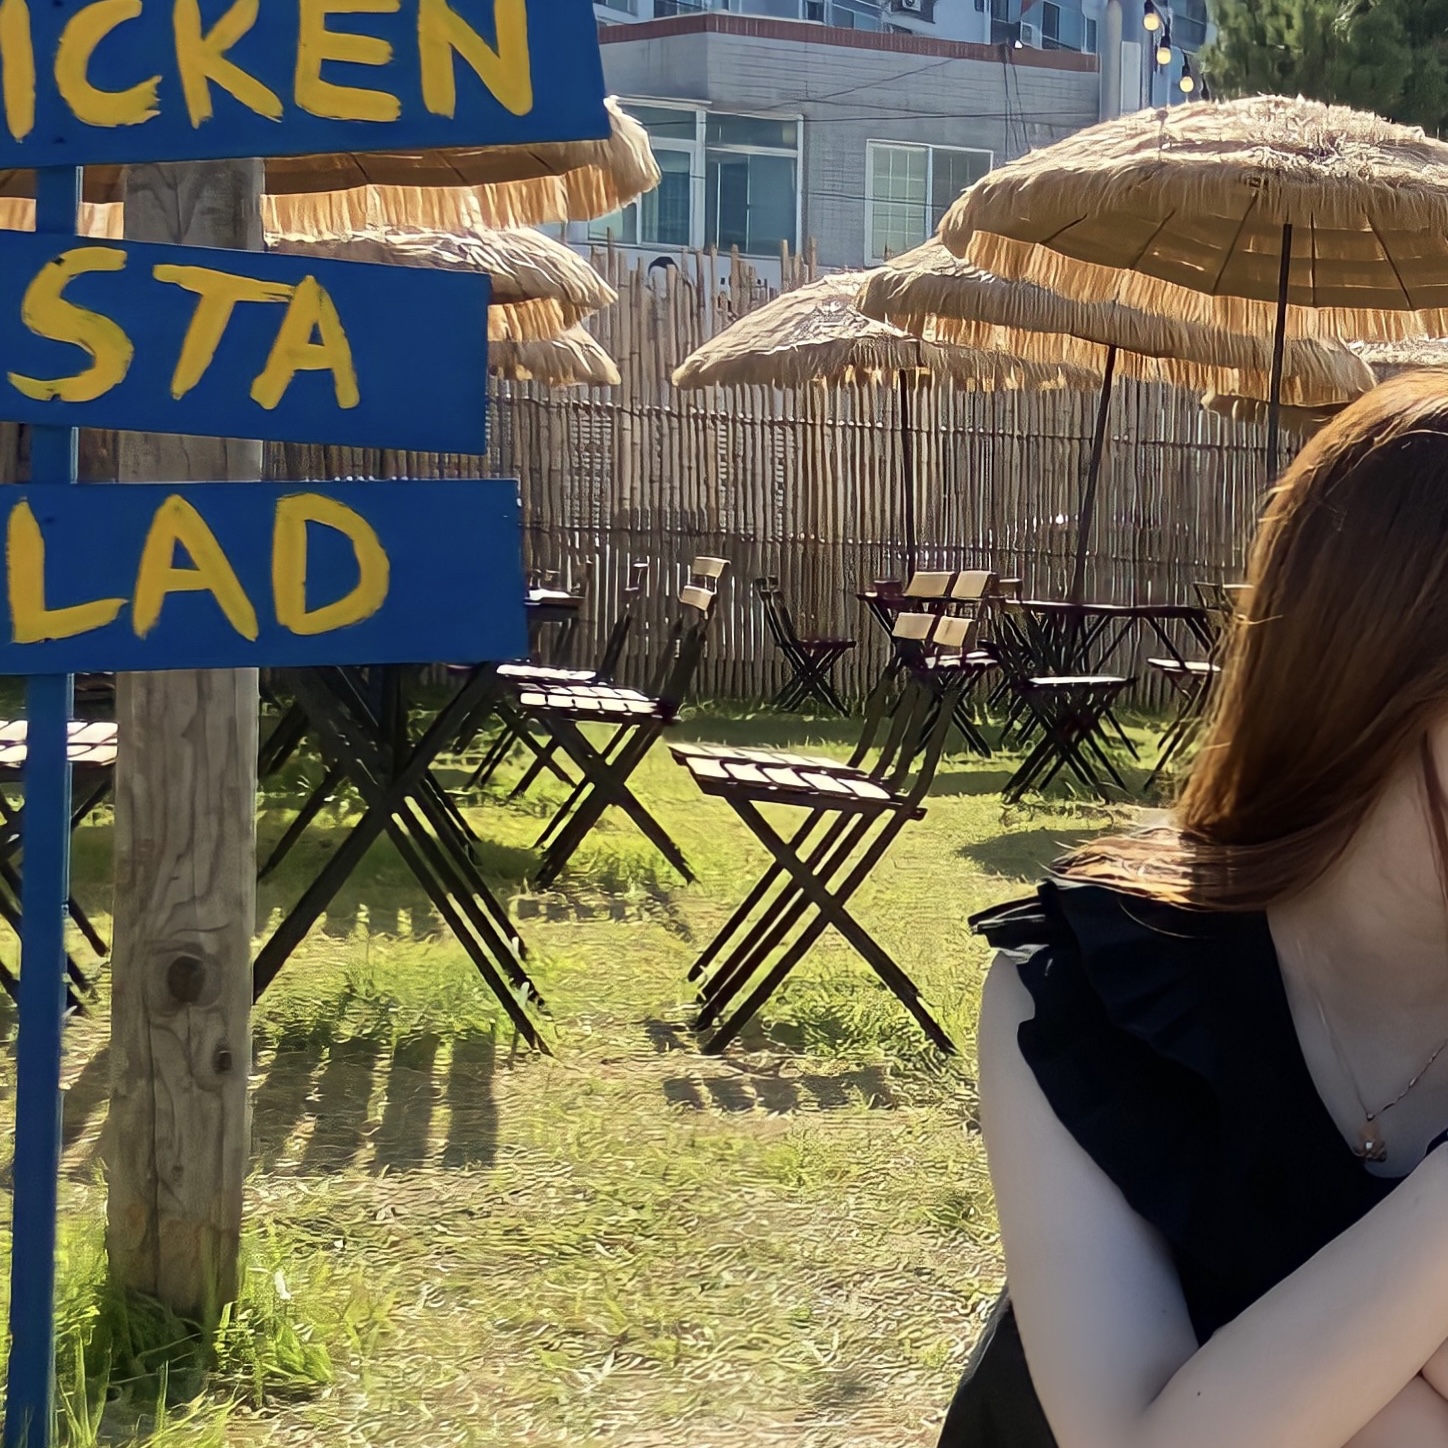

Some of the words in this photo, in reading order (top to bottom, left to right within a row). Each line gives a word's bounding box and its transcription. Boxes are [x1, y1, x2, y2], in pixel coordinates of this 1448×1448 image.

[0, 0, 534, 143] ICKEN
[7, 246, 360, 410] STA
[6, 493, 390, 644] LAD
